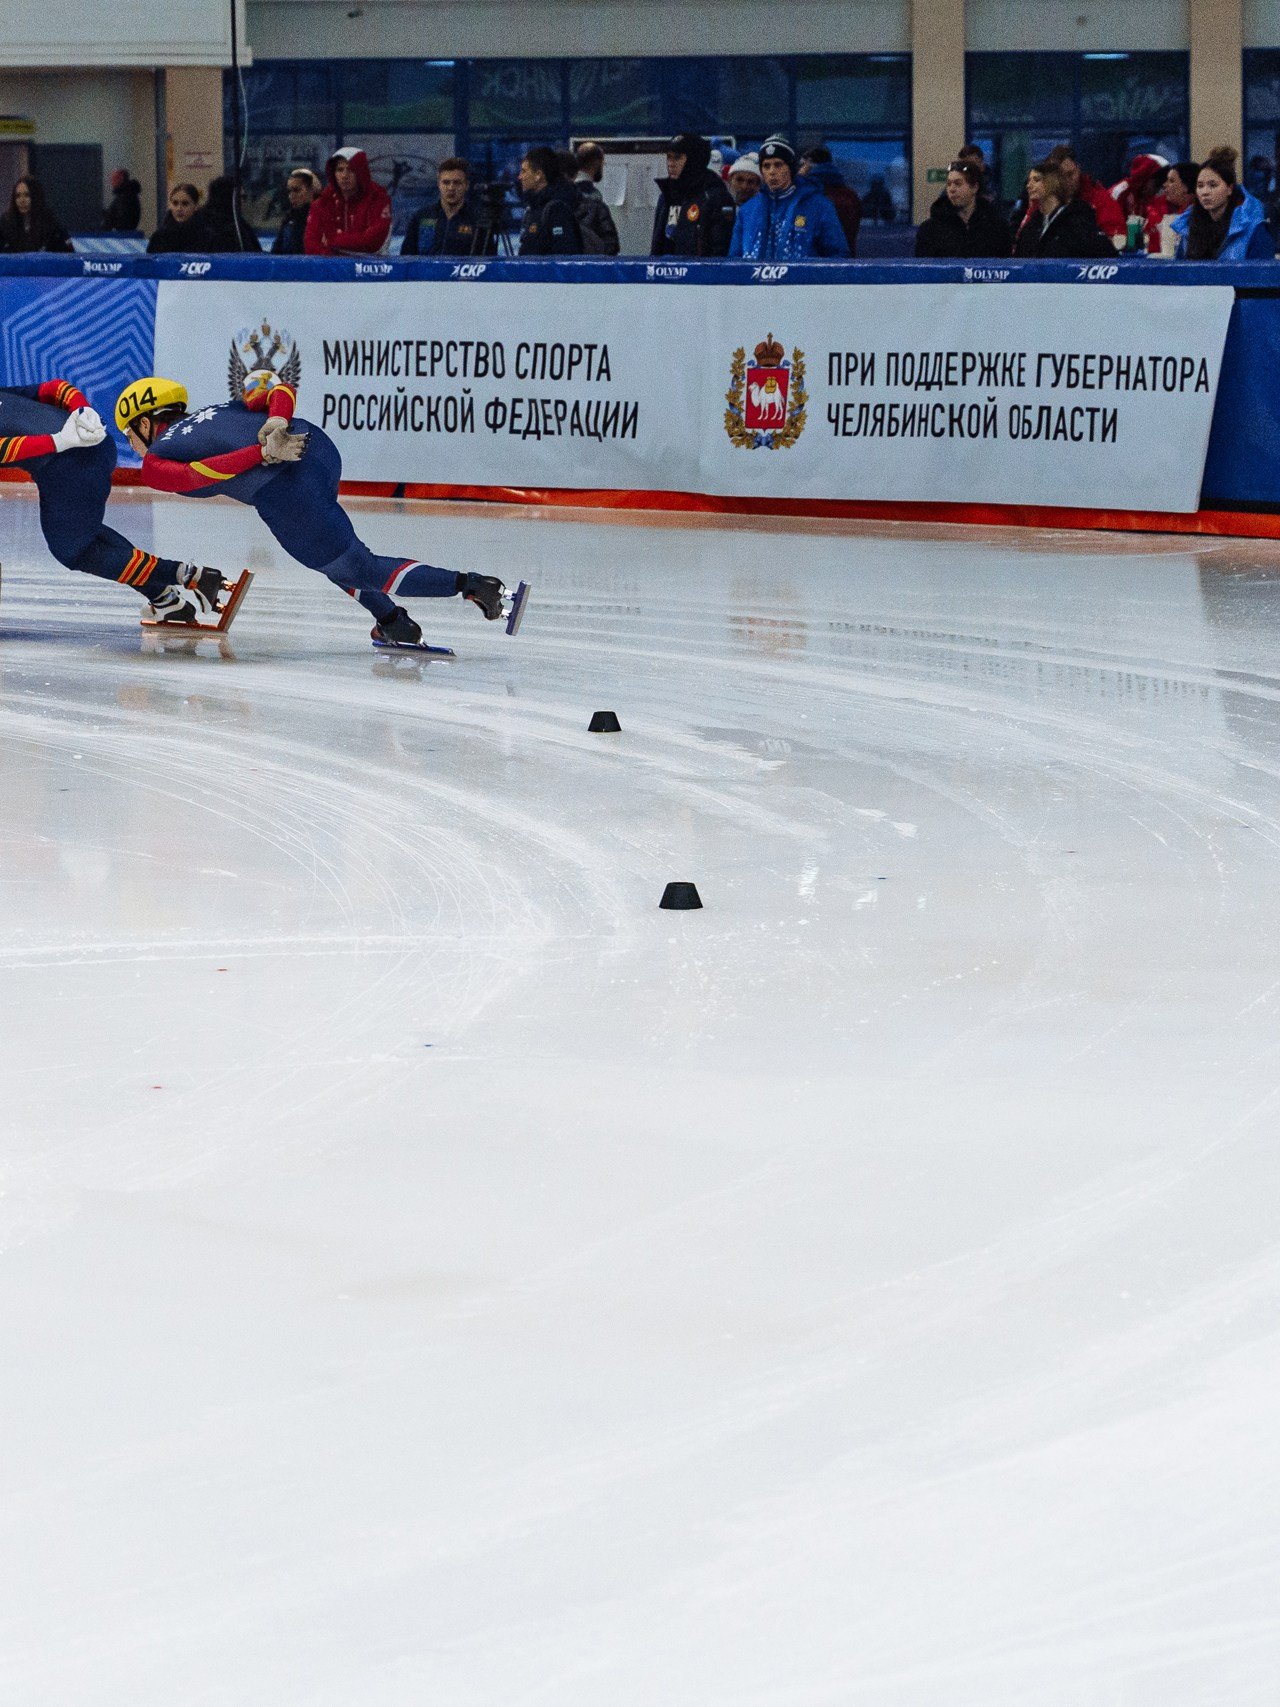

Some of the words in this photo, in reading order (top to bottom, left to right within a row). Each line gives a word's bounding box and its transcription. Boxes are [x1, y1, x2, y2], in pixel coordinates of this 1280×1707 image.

[91, 263, 122, 271] OLYMP
[363, 265, 393, 274] OLYMP
[656, 267, 688, 276] OLYMP
[974, 270, 1009, 279] OLYMP
[322, 340, 506, 379] МИНИСТЕРСТВО
[515, 342, 611, 382] СПОРТА
[828, 352, 876, 387] ПРИ
[886, 351, 1027, 392] ПОДДЕРЖКЕ
[1035, 352, 1210, 393] ГУБЕРНАТОРА
[119, 386, 157, 418] 014
[321, 387, 475, 434] РОССИЙСКОЙ
[484, 396, 639, 443] ФЕДЕРАЦИИ
[827, 396, 998, 439] ЧЕЛЯБИНСКОЙ
[1008, 404, 1118, 443] ОБЛАСТИ
